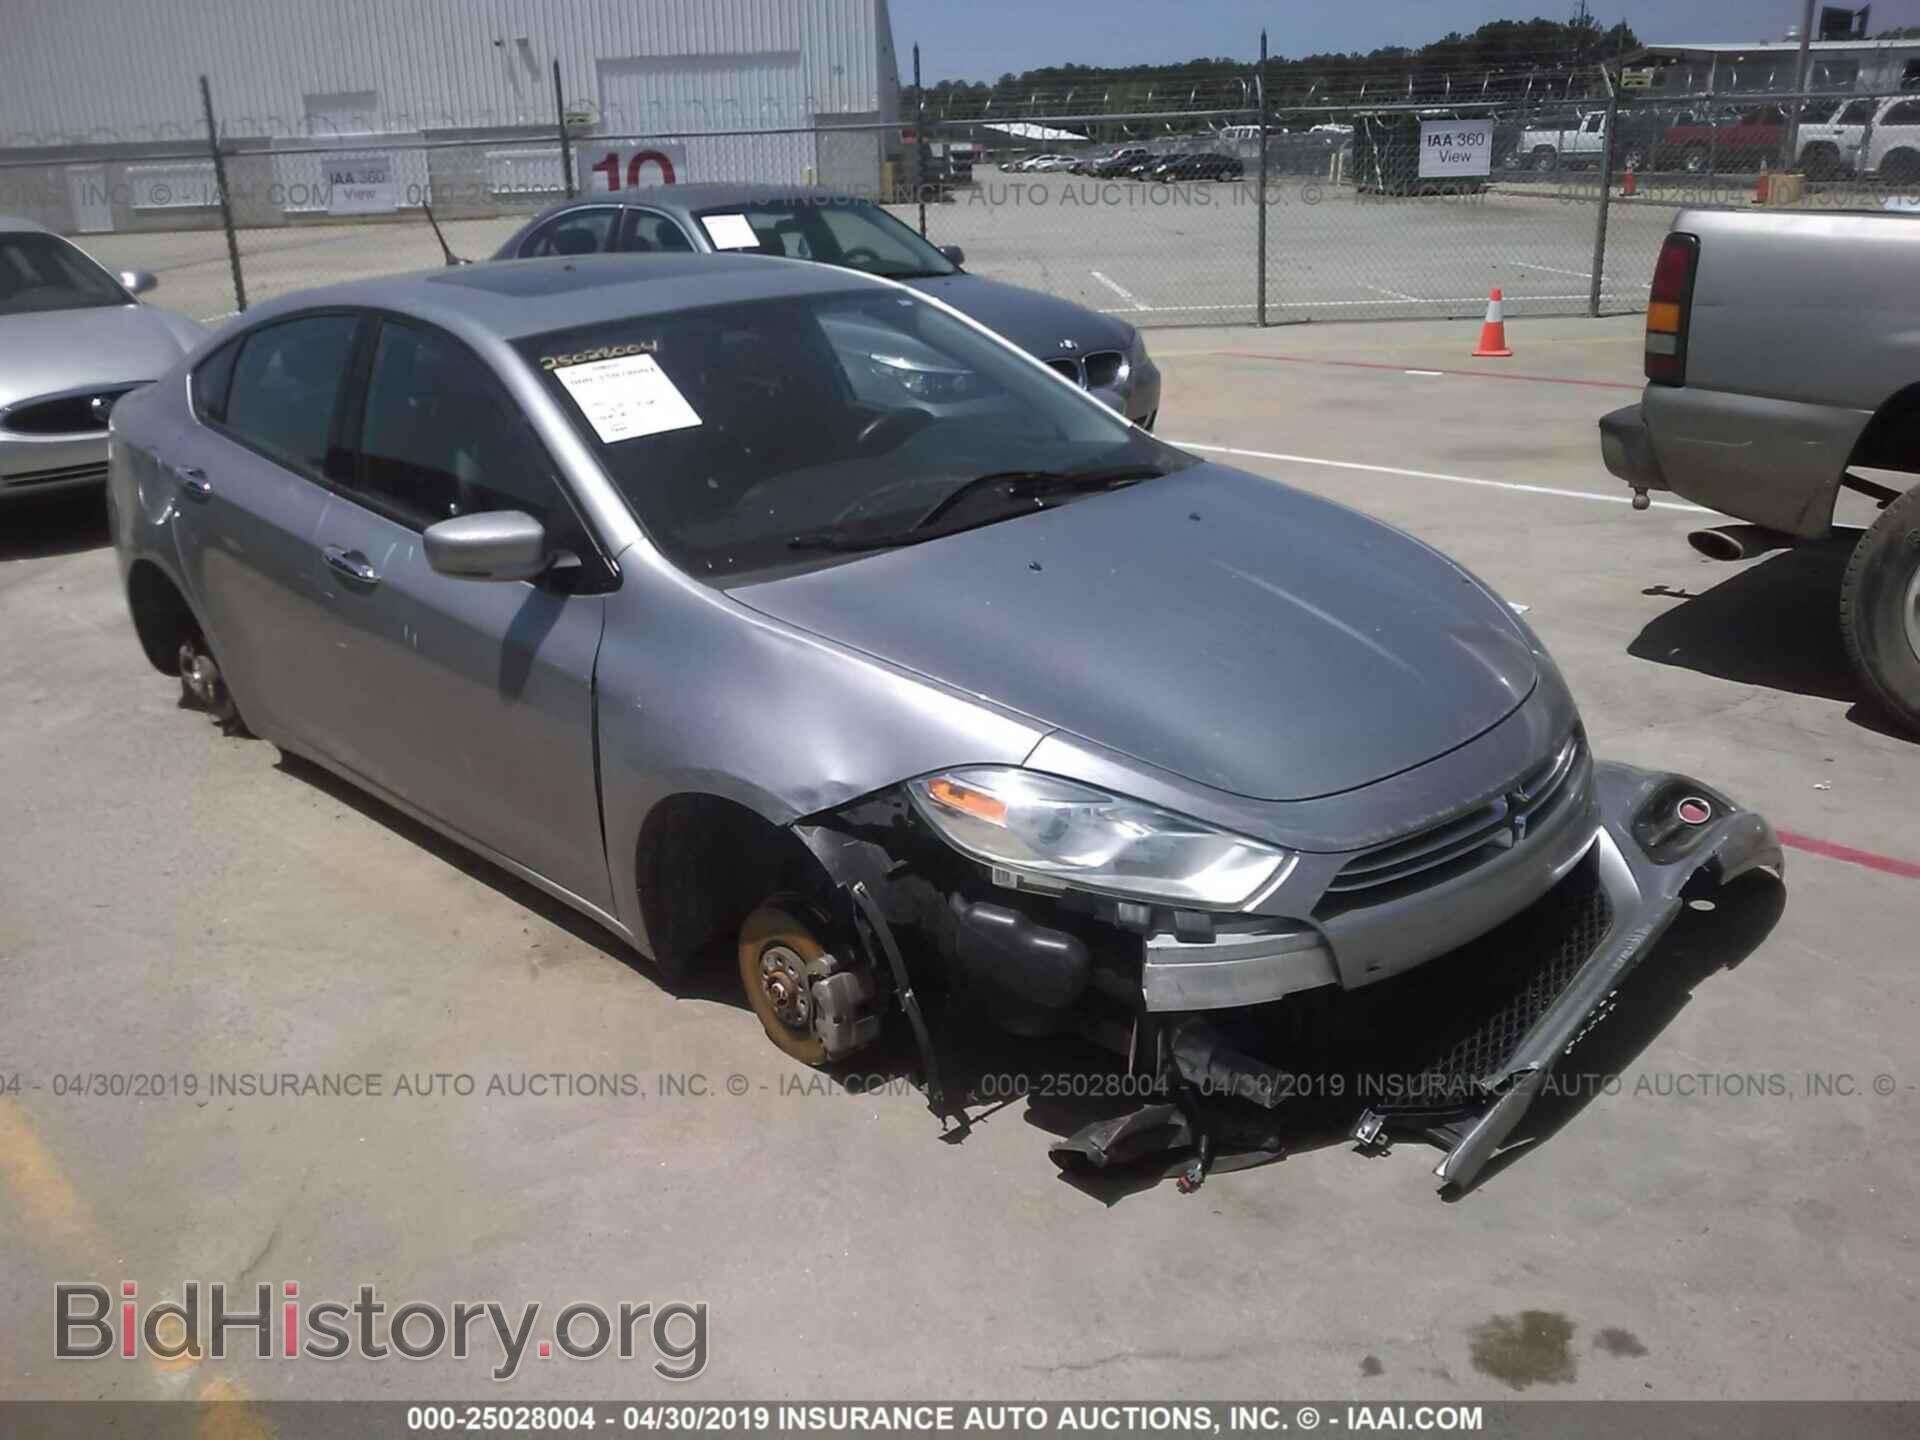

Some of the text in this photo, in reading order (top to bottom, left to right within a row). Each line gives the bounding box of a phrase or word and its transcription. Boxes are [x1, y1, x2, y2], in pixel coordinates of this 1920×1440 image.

[1427, 131, 1485, 147] IAA 360
[1440, 150, 1472, 163] View
[329, 171, 355, 185] IAA
